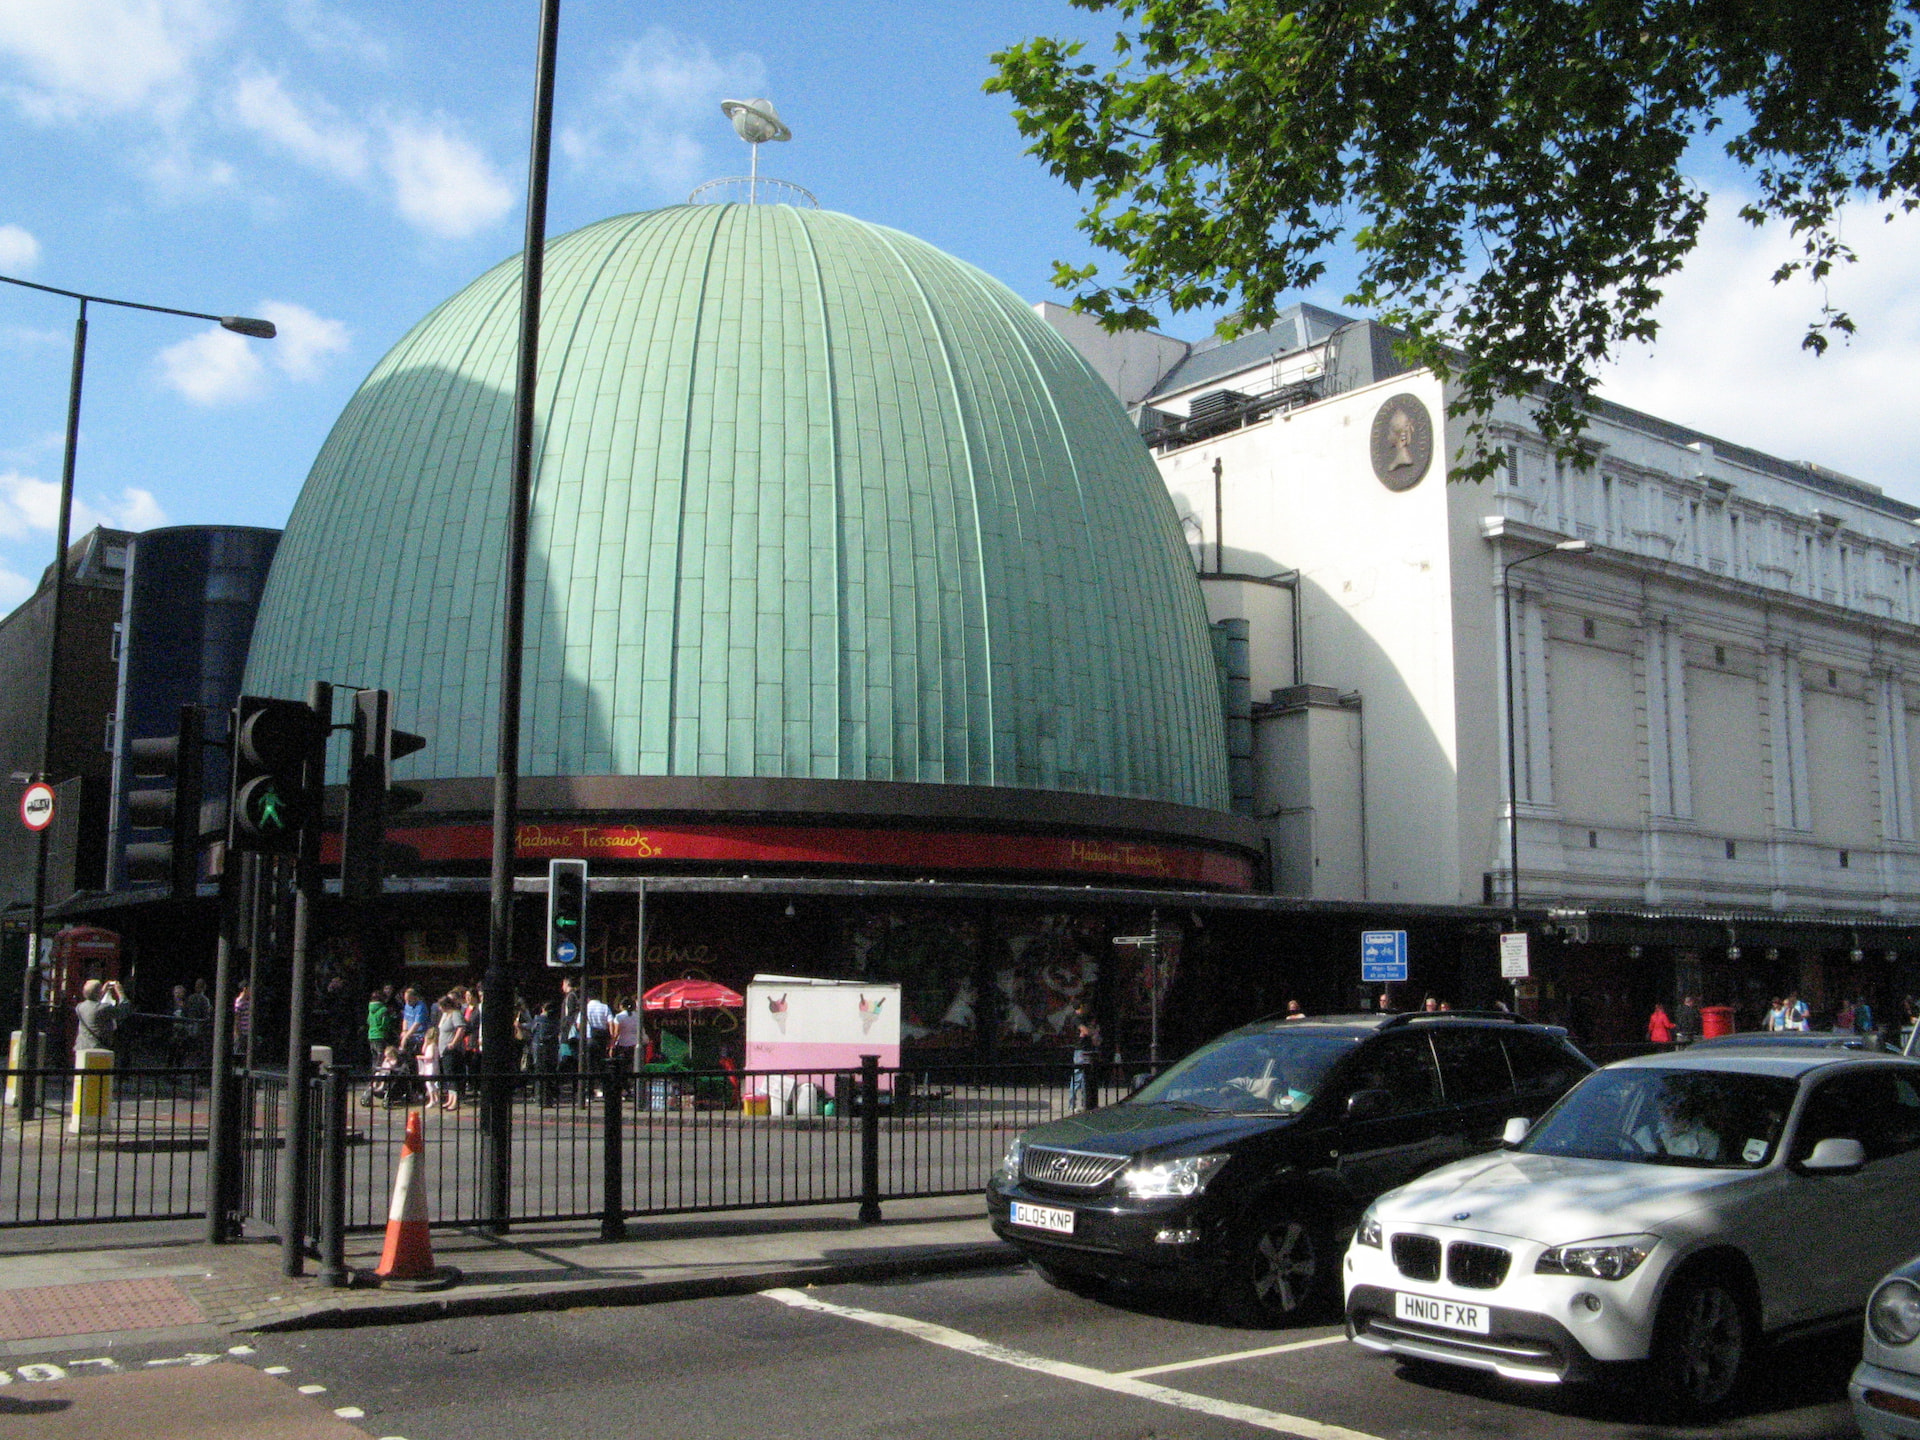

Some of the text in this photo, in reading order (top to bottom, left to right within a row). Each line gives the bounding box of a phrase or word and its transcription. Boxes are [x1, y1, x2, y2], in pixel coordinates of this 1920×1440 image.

[573, 824, 652, 857] Tussauds
[1050, 1211, 1072, 1229] KNP
[1405, 1297, 1477, 1327] HN10 FXR
